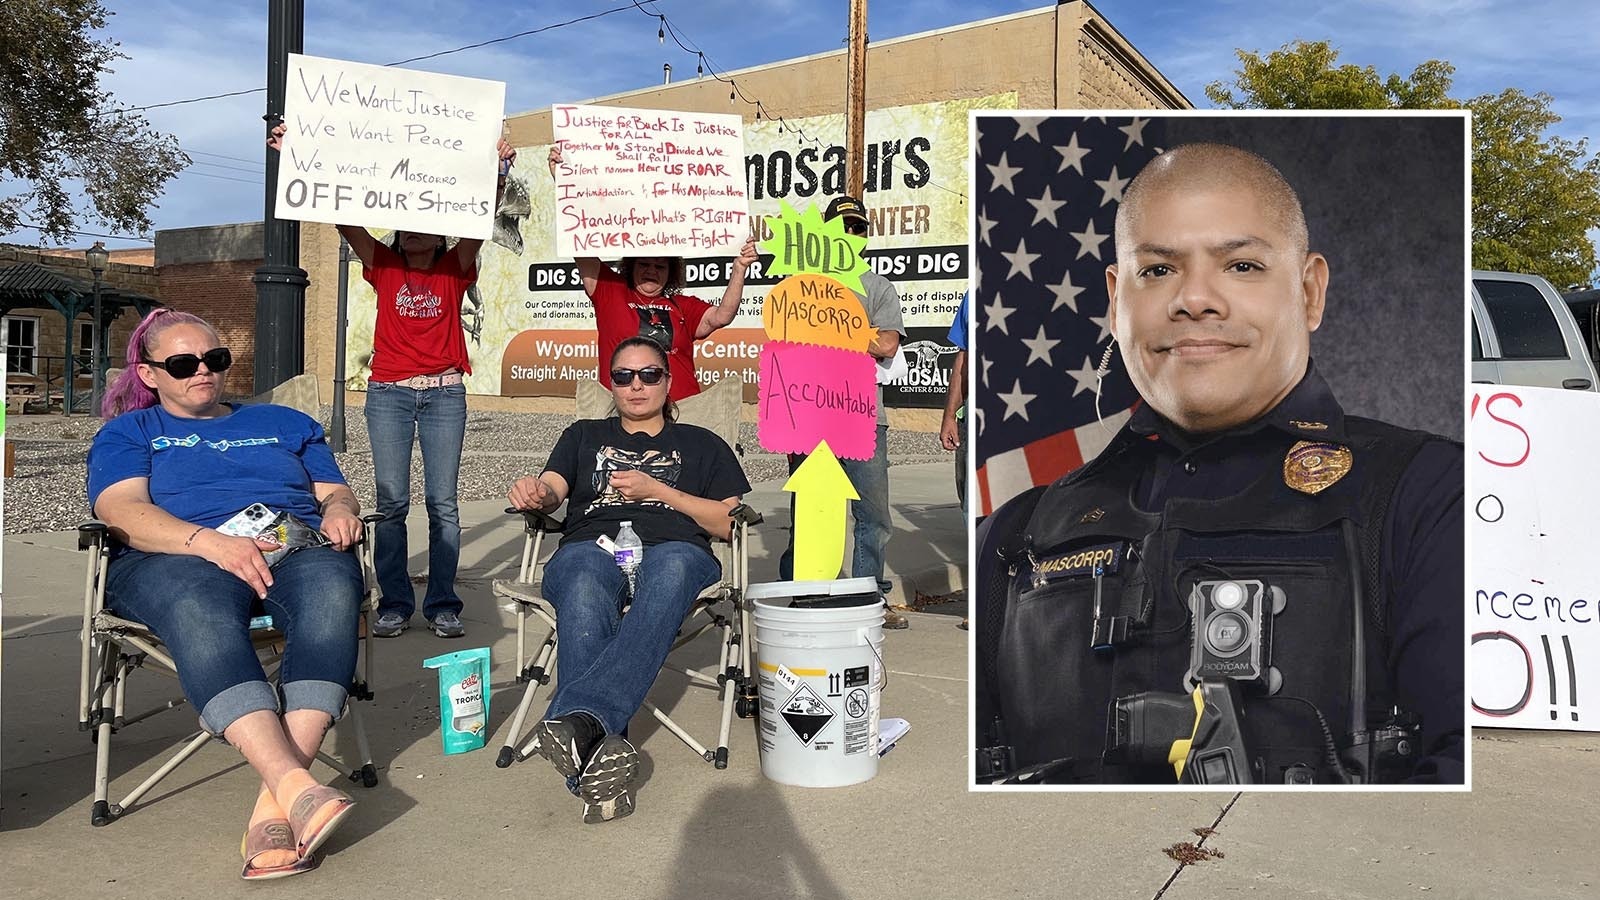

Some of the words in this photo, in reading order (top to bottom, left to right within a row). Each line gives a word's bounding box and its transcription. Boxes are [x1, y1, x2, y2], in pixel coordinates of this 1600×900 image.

[300, 68, 350, 106] We
[355, 83, 402, 112] Want
[406, 89, 477, 121] Justice
[556, 106, 613, 128] Justice
[631, 116, 669, 131] Buck
[671, 118, 684, 132] Is
[693, 121, 738, 138] Justice
[297, 114, 335, 138] We
[349, 120, 394, 143] Want
[403, 124, 464, 151] Peace
[624, 130, 653, 140] ALL
[556, 140, 602, 154] Together
[605, 142, 620, 151] We
[624, 142, 664, 154] Stand
[665, 142, 704, 156] Divided
[706, 146, 729, 157] We
[616, 152, 642, 160] Shall
[648, 152, 670, 162] fall
[290, 147, 325, 172] We
[336, 161, 382, 177] want
[560, 162, 598, 176] Silent
[664, 164, 684, 176] US
[687, 162, 731, 177] ROAR
[285, 178, 353, 210] OFF
[418, 190, 489, 217] Streets
[558, 184, 634, 201] Intimidation
[562, 205, 612, 232] Stand
[613, 213, 628, 228] Up
[628, 208, 650, 226] for
[651, 208, 687, 224] What's
[692, 207, 746, 224] RIGHT
[866, 204, 930, 237] NTER
[574, 232, 636, 251] NEVER
[657, 232, 669, 246] Up
[671, 234, 687, 245] the
[688, 227, 735, 249] Fight
[784, 222, 856, 274] HOLD
[685, 263, 720, 282] DIG
[864, 255, 910, 275] IDS'
[918, 252, 960, 274] DIG
[536, 269, 566, 286] DIG
[541, 300, 574, 311] Complex
[917, 292, 928, 301] of
[532, 310, 547, 318] and
[770, 290, 862, 344] MASCORRO
[911, 304, 930, 314] gift
[510, 365, 557, 382] Straight
[560, 365, 598, 381] Ahead
[1476, 590, 1600, 623] rceme
[1204, 663, 1249, 671] BODYCAM
[803, 732, 809, 740] 8
